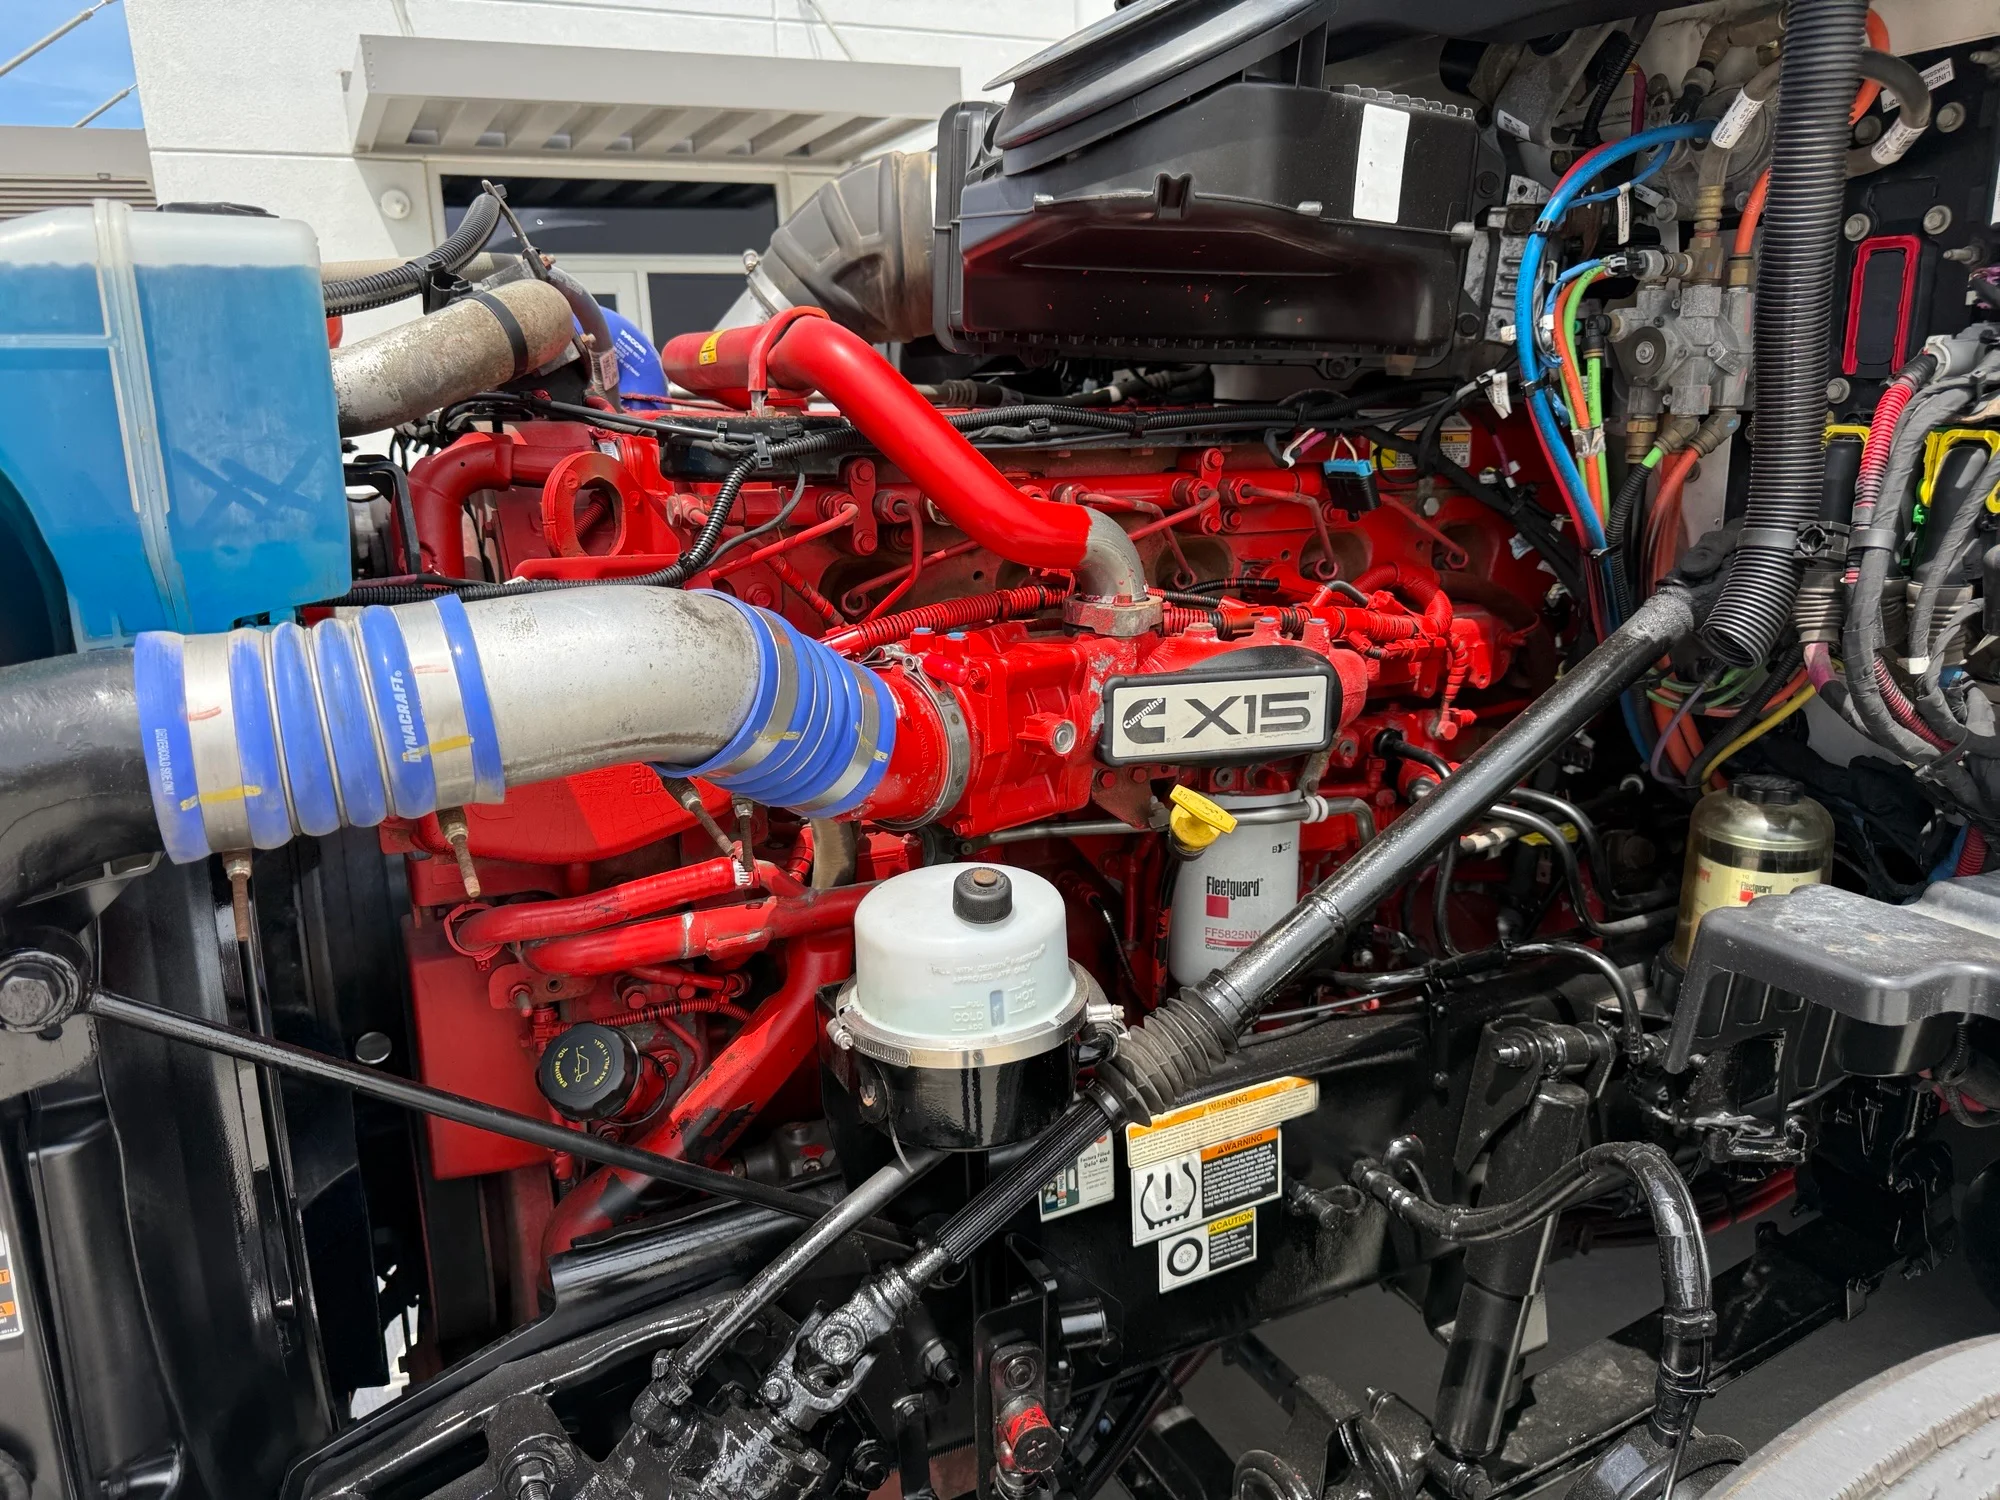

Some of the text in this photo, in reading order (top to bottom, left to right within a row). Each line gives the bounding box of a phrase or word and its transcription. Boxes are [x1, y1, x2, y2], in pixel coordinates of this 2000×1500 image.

[1123, 698, 1164, 729] Cummins
[1015, 988, 1034, 1002] HOT
[954, 1012, 983, 1022] COLD
[554, 1047, 569, 1088] ENGINE OIL
[594, 1071, 607, 1086] MAX
[1208, 1094, 1248, 1111] WARNING
[1223, 1134, 1262, 1151] WARNING
[1216, 1212, 1253, 1230] CAUTION
